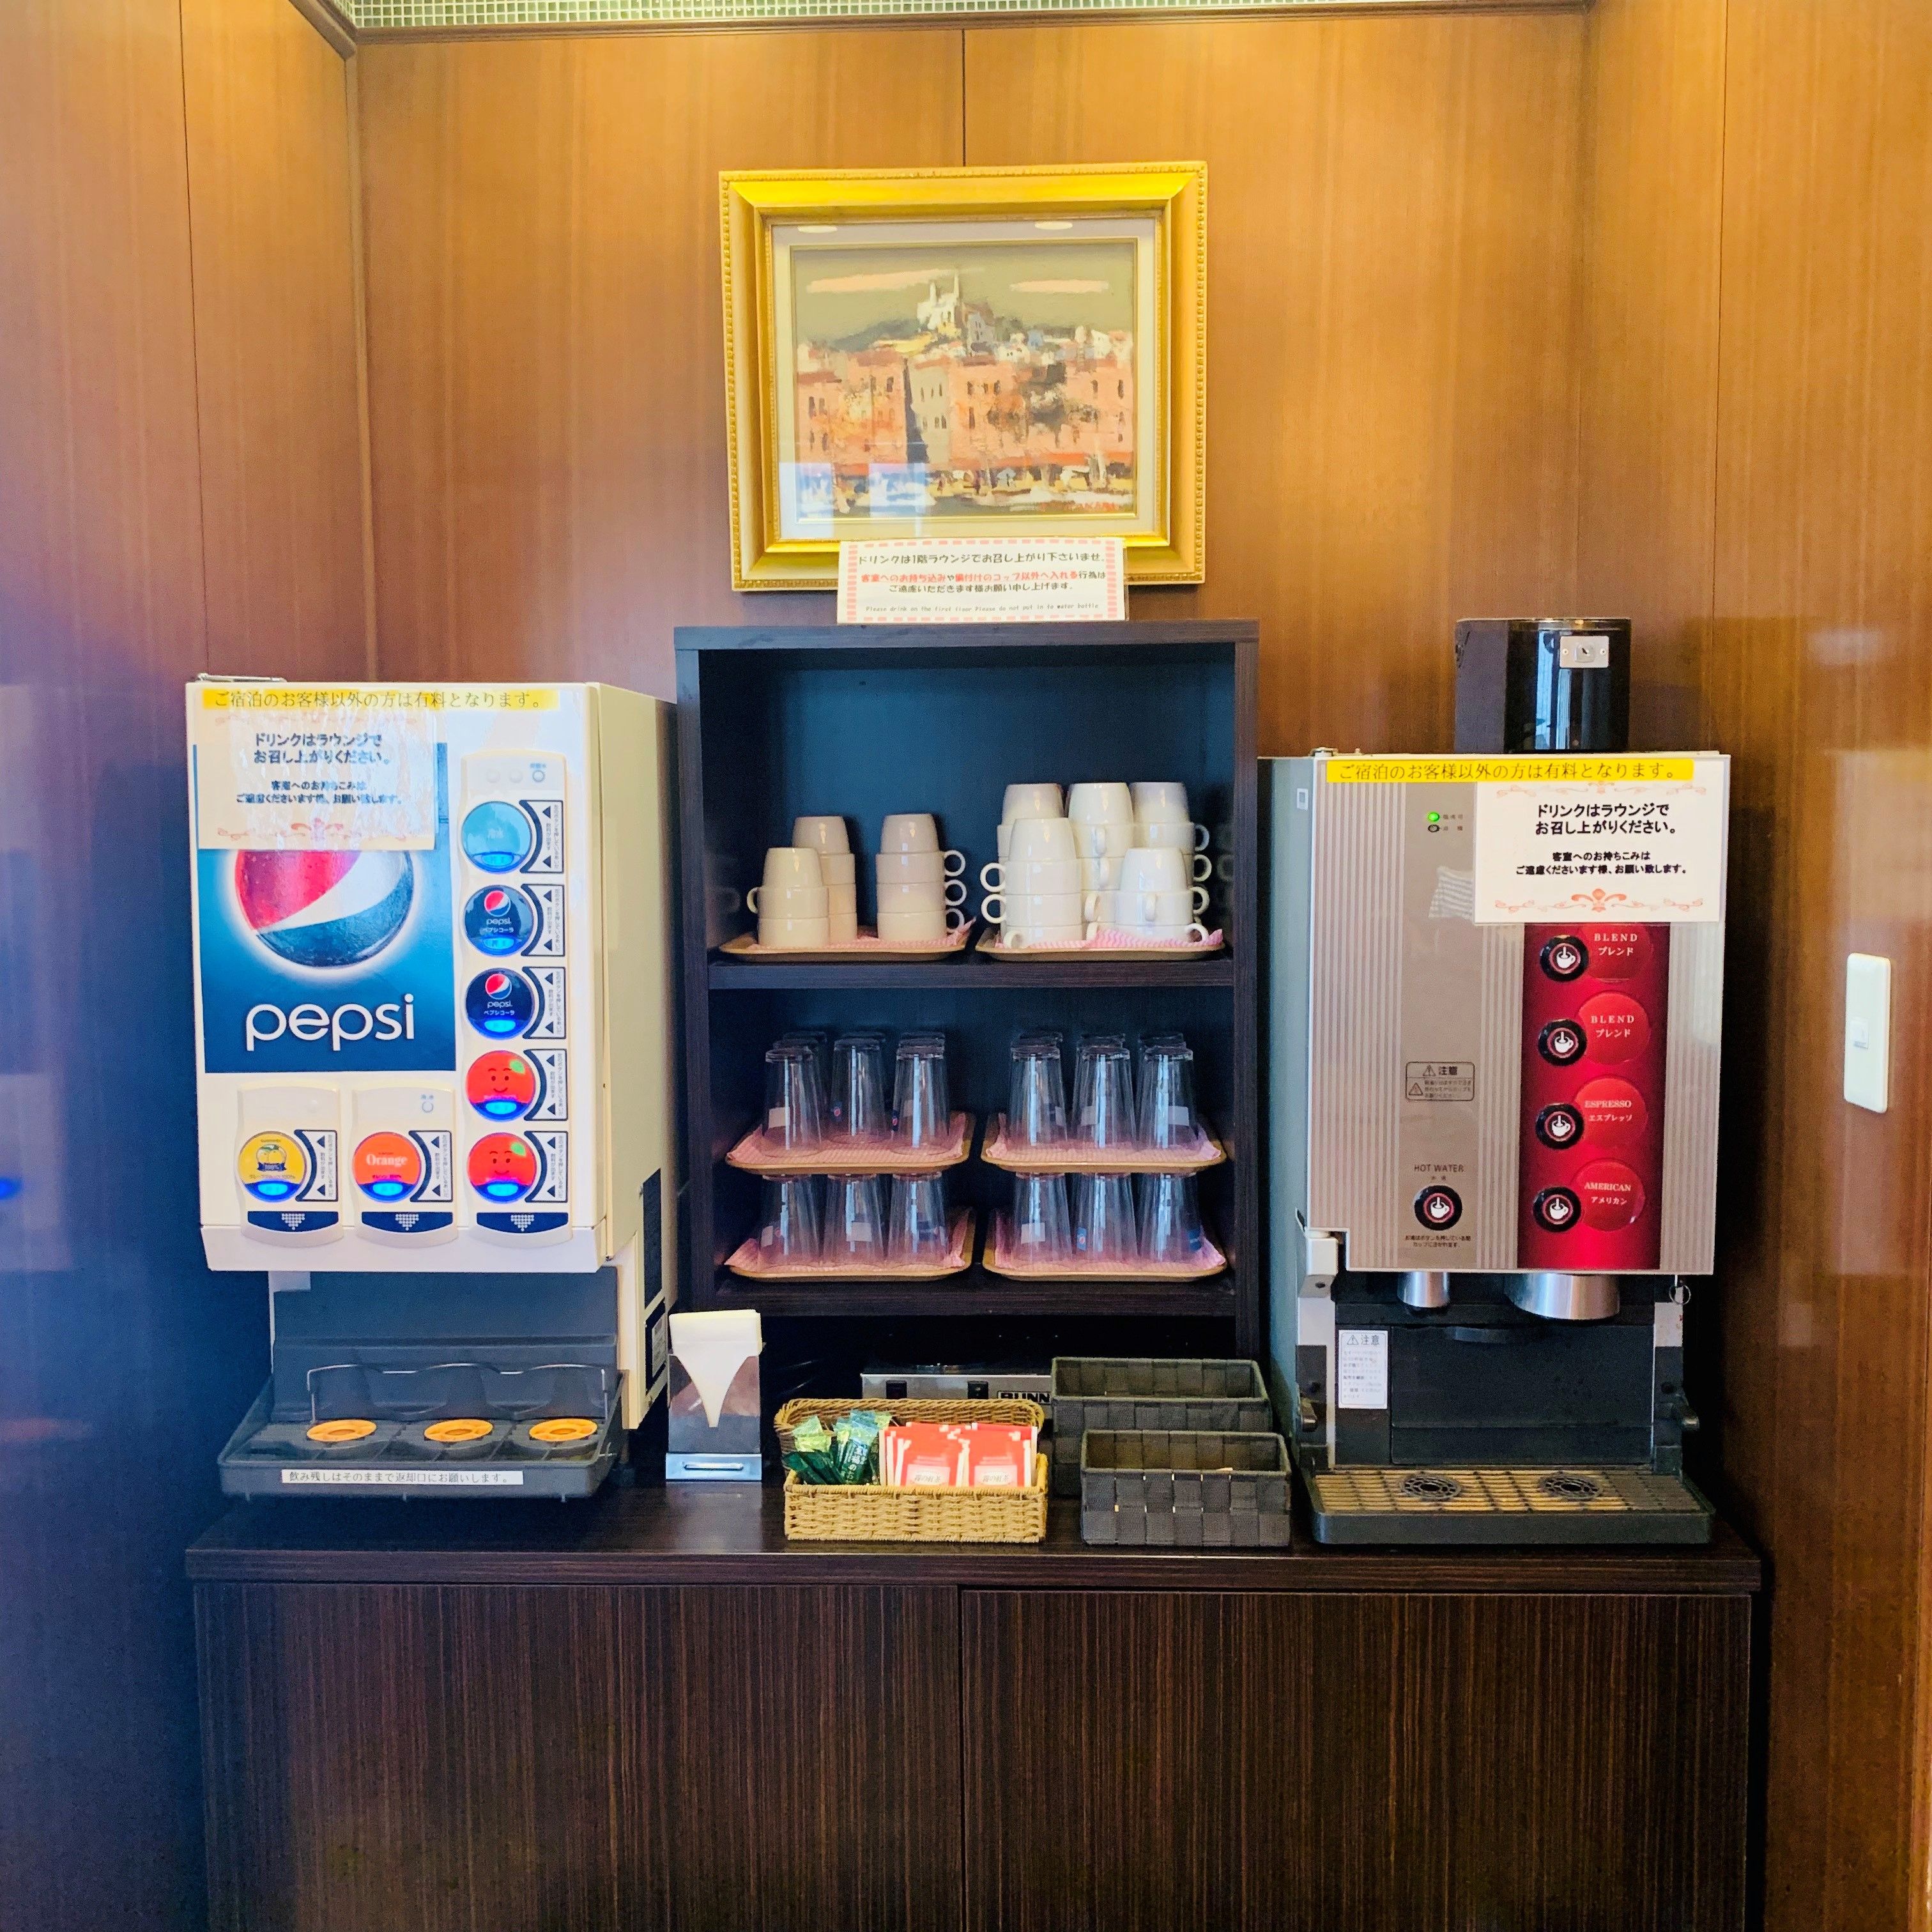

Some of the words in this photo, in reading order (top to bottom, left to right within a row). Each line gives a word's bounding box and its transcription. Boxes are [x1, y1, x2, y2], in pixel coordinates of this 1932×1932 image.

[215, 691, 540, 708] ご宿泊のお客様以外の方は有料となります。
[255, 733, 382, 747] ドリンクはラウンジで
[254, 749, 390, 765] お召し上がりください。
[1339, 762, 1675, 780] ご宿泊のお客様以外の方は有料となります。
[1538, 803, 1669, 818] ドリンクはラウンジで
[1535, 820, 1676, 836] お召し上がりください。
[1552, 850, 1651, 861] 客室へのお持ちこみは
[1515, 863, 1687, 875] ご遠慮くださいます様、お願い致します。
[486, 917, 512, 926] pepsi
[1593, 933, 1638, 942] BLEND
[1598, 946, 1634, 956] ブレンド
[487, 1000, 512, 1009] pepsi
[245, 993, 415, 1052] pepsi
[1591, 1015, 1635, 1024] BLEND
[1595, 1028, 1631, 1038] ブレンド
[1584, 1100, 1632, 1108] ESPRESSO
[1588, 1114, 1632, 1123] エスプレッソ
[365, 1153, 408, 1168] Orange
[1414, 1163, 1430, 1172] HOT
[1434, 1163, 1464, 1173] WATER
[1584, 1182, 1632, 1192] AMERICAN
[1590, 1196, 1628, 1206] アメリカン
[1360, 1334, 1380, 1346] 注意
[289, 1471, 508, 1483] 飲み残しはそのままで返却口にお願いします。
